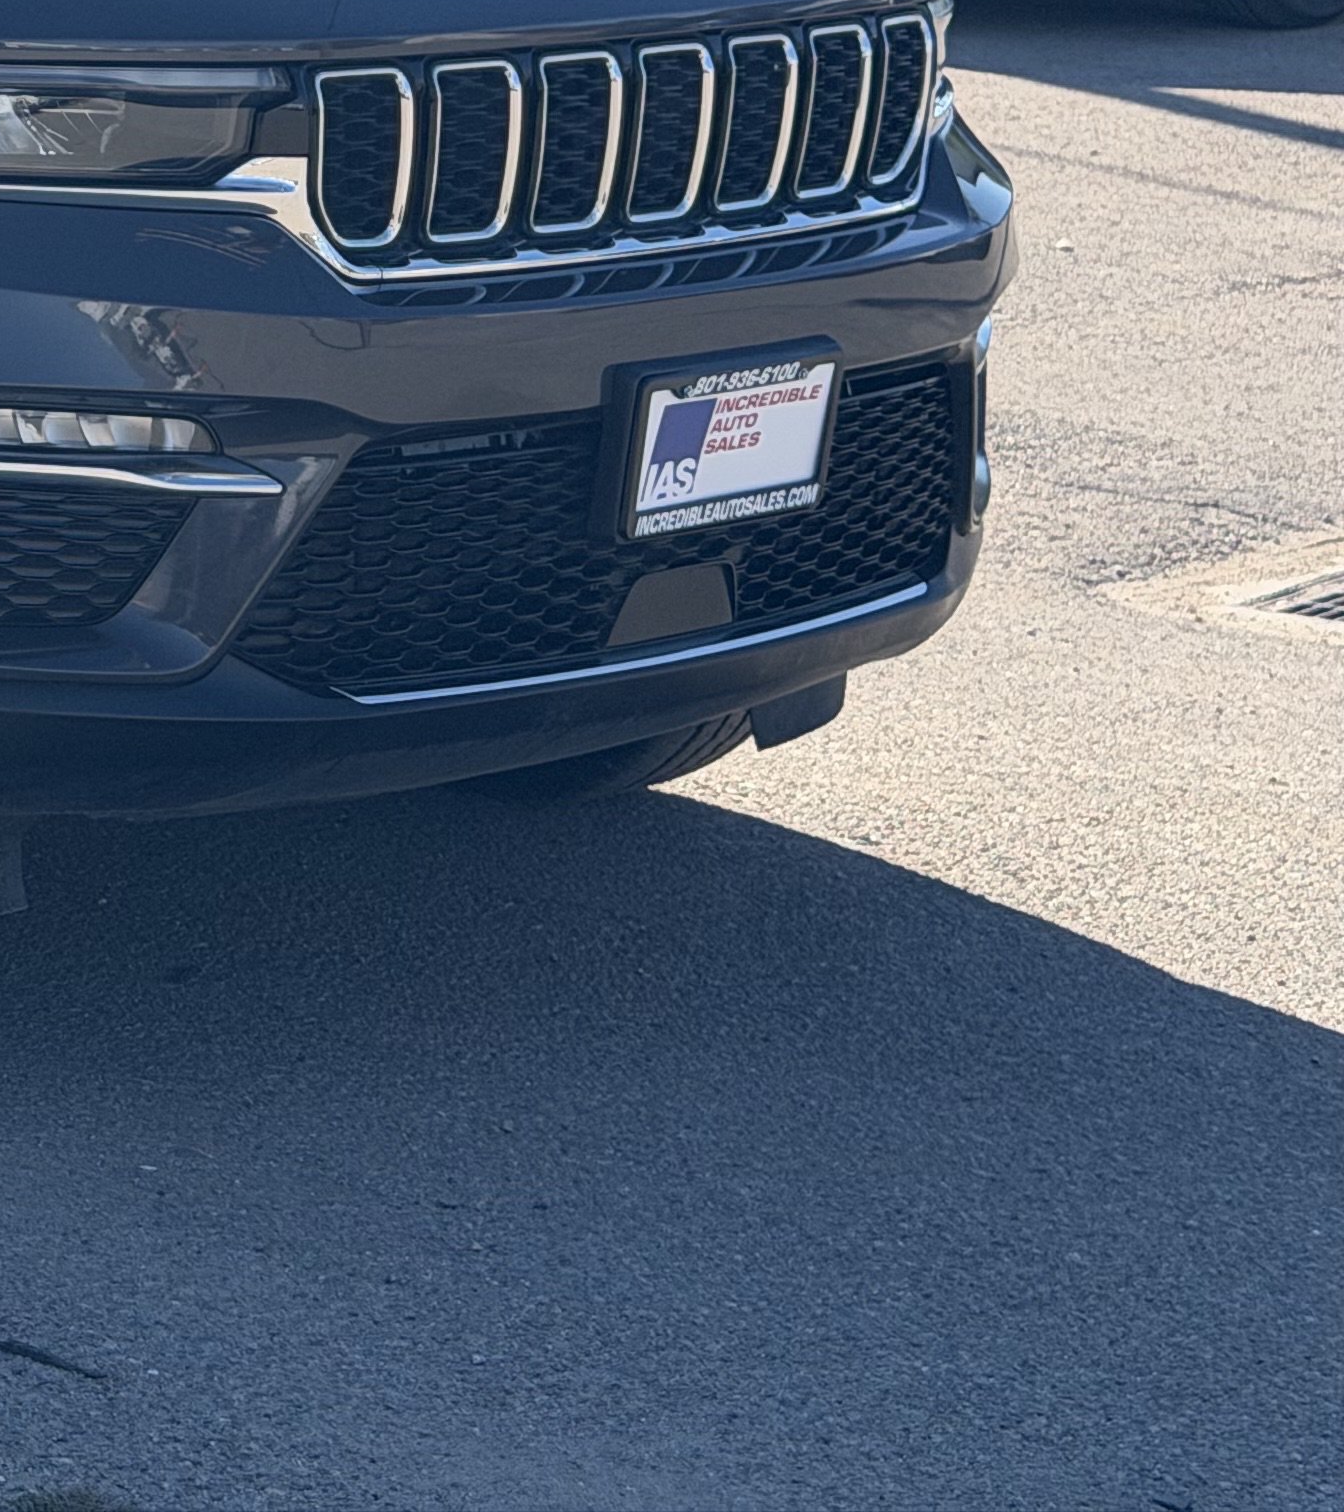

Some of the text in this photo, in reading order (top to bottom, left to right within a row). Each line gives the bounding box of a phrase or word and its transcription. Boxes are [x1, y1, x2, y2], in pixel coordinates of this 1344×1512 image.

[694, 361, 800, 395] 801-936-6100
[717, 385, 821, 413] INCREDIBLE
[712, 414, 758, 433] AUTO
[705, 432, 760, 454] SALES
[640, 457, 697, 504] IAS
[635, 484, 819, 536] INCREDIBLEAUTOSALES.COM
